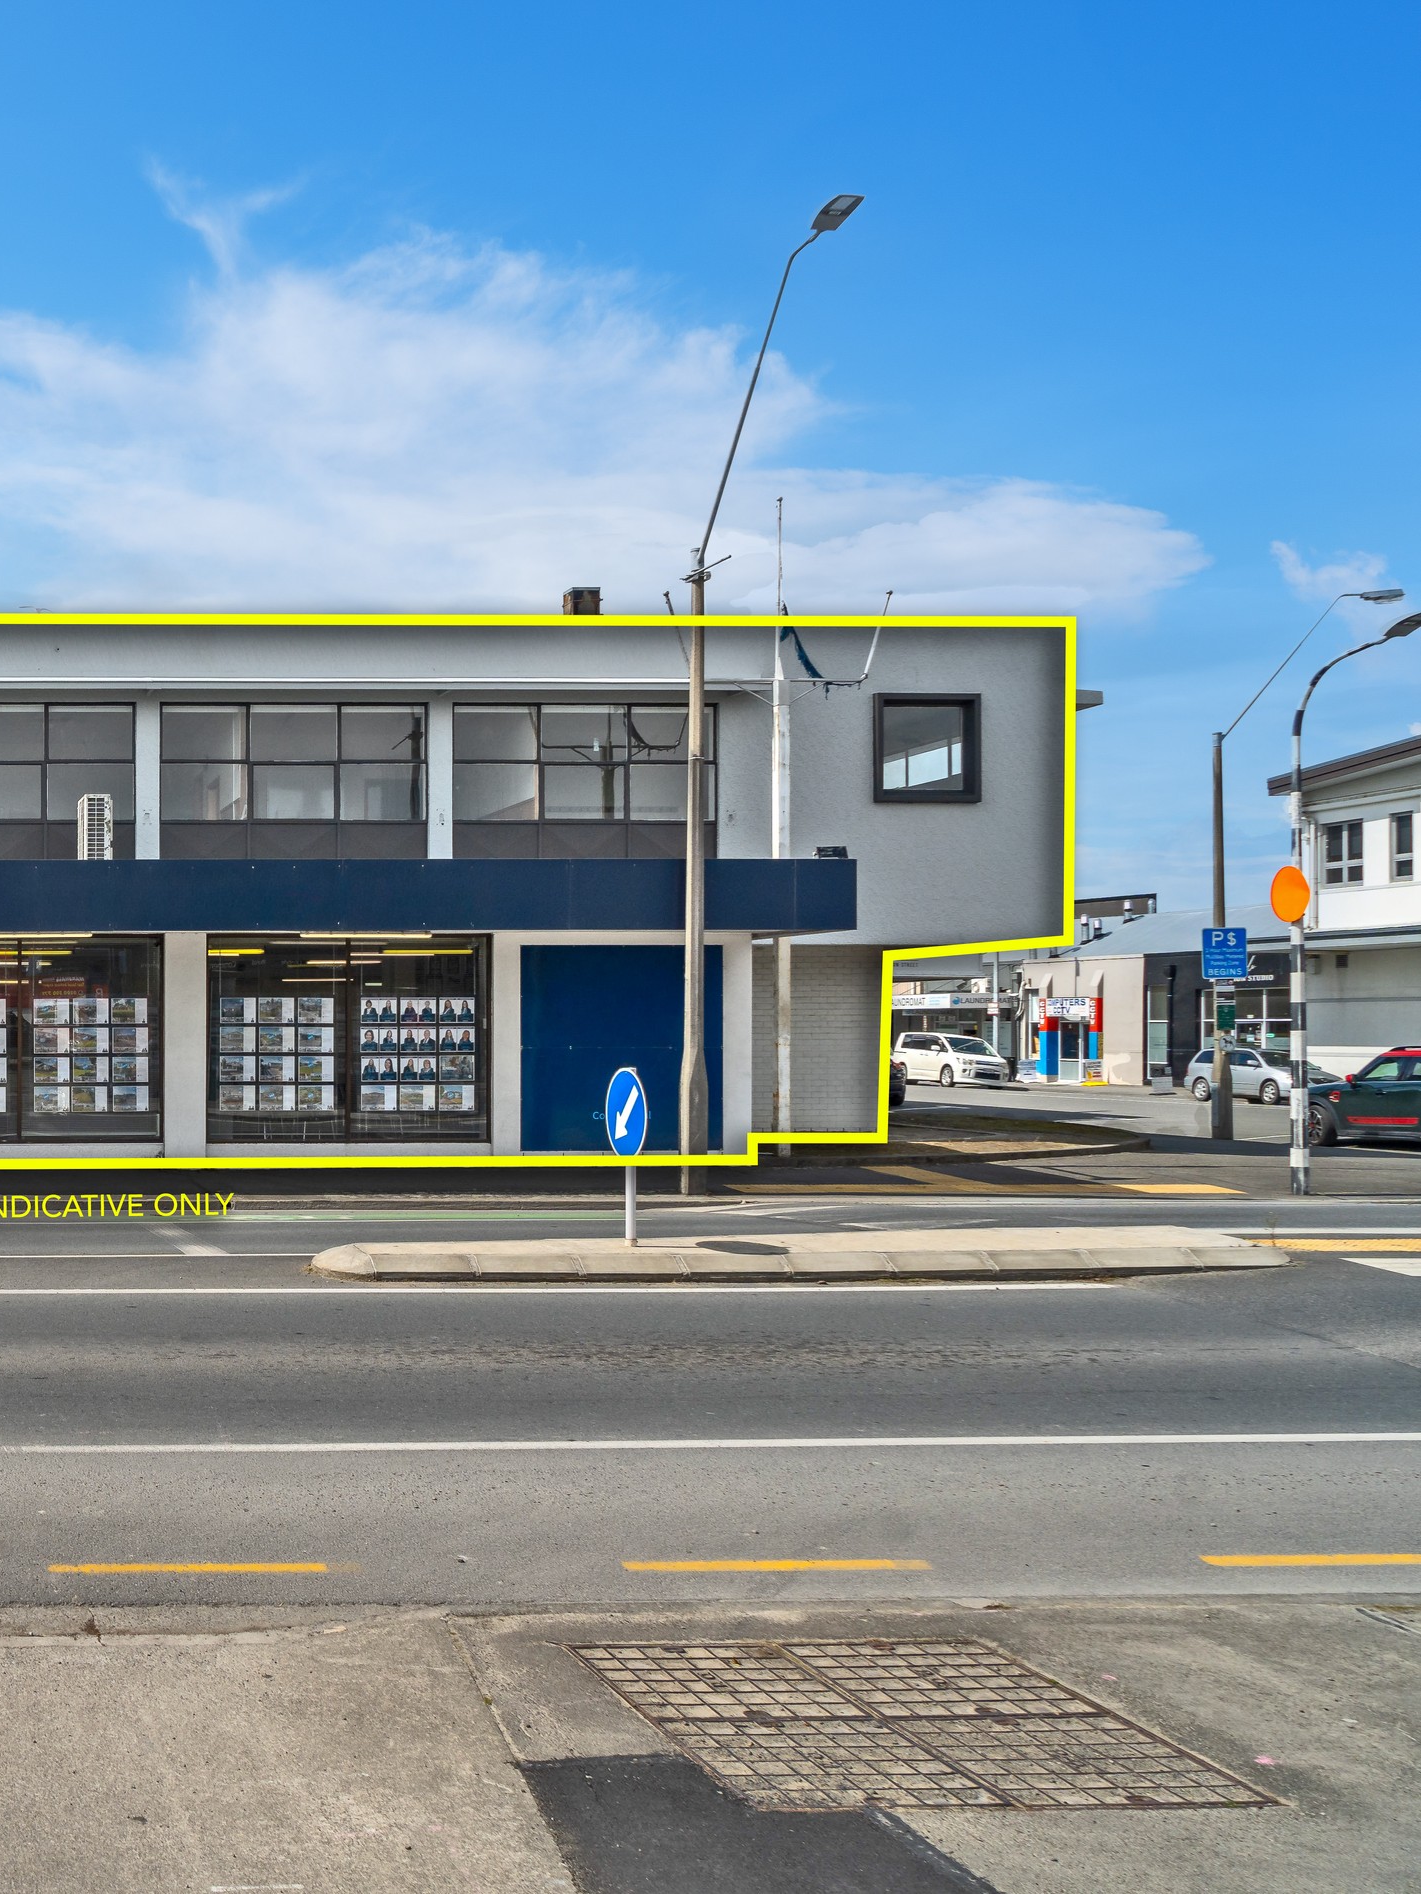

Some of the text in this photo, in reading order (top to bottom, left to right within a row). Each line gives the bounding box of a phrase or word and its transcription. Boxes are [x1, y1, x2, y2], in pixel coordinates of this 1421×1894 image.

[1212, 932, 1236, 946] P $
[1208, 968, 1242, 976] BEGINS
[1053, 1006, 1071, 1014] CCTV
